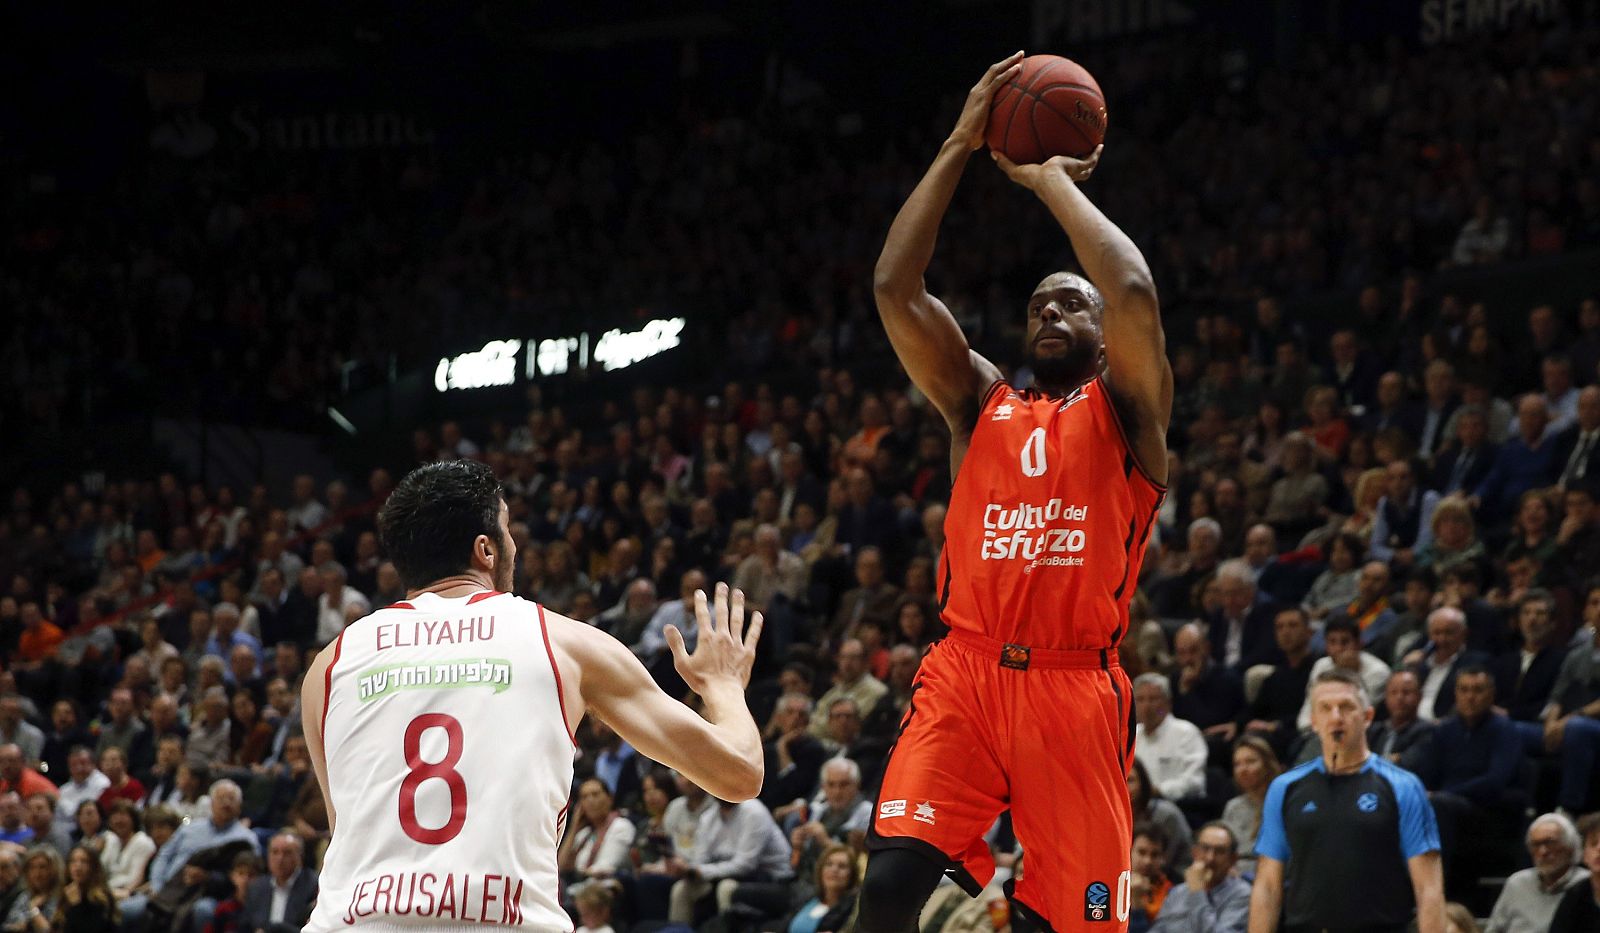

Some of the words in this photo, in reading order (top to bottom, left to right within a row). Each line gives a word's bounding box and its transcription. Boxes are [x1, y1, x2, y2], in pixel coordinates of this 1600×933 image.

[1020, 426, 1048, 478] 0
[1063, 504, 1088, 521] del
[376, 615, 495, 651] ELIYAHU
[360, 664, 431, 698] החדשה
[434, 658, 511, 685] תלפיות
[398, 712, 468, 845] 8
[343, 872, 524, 926] JERUSALEM
[1116, 870, 1131, 923] 0
